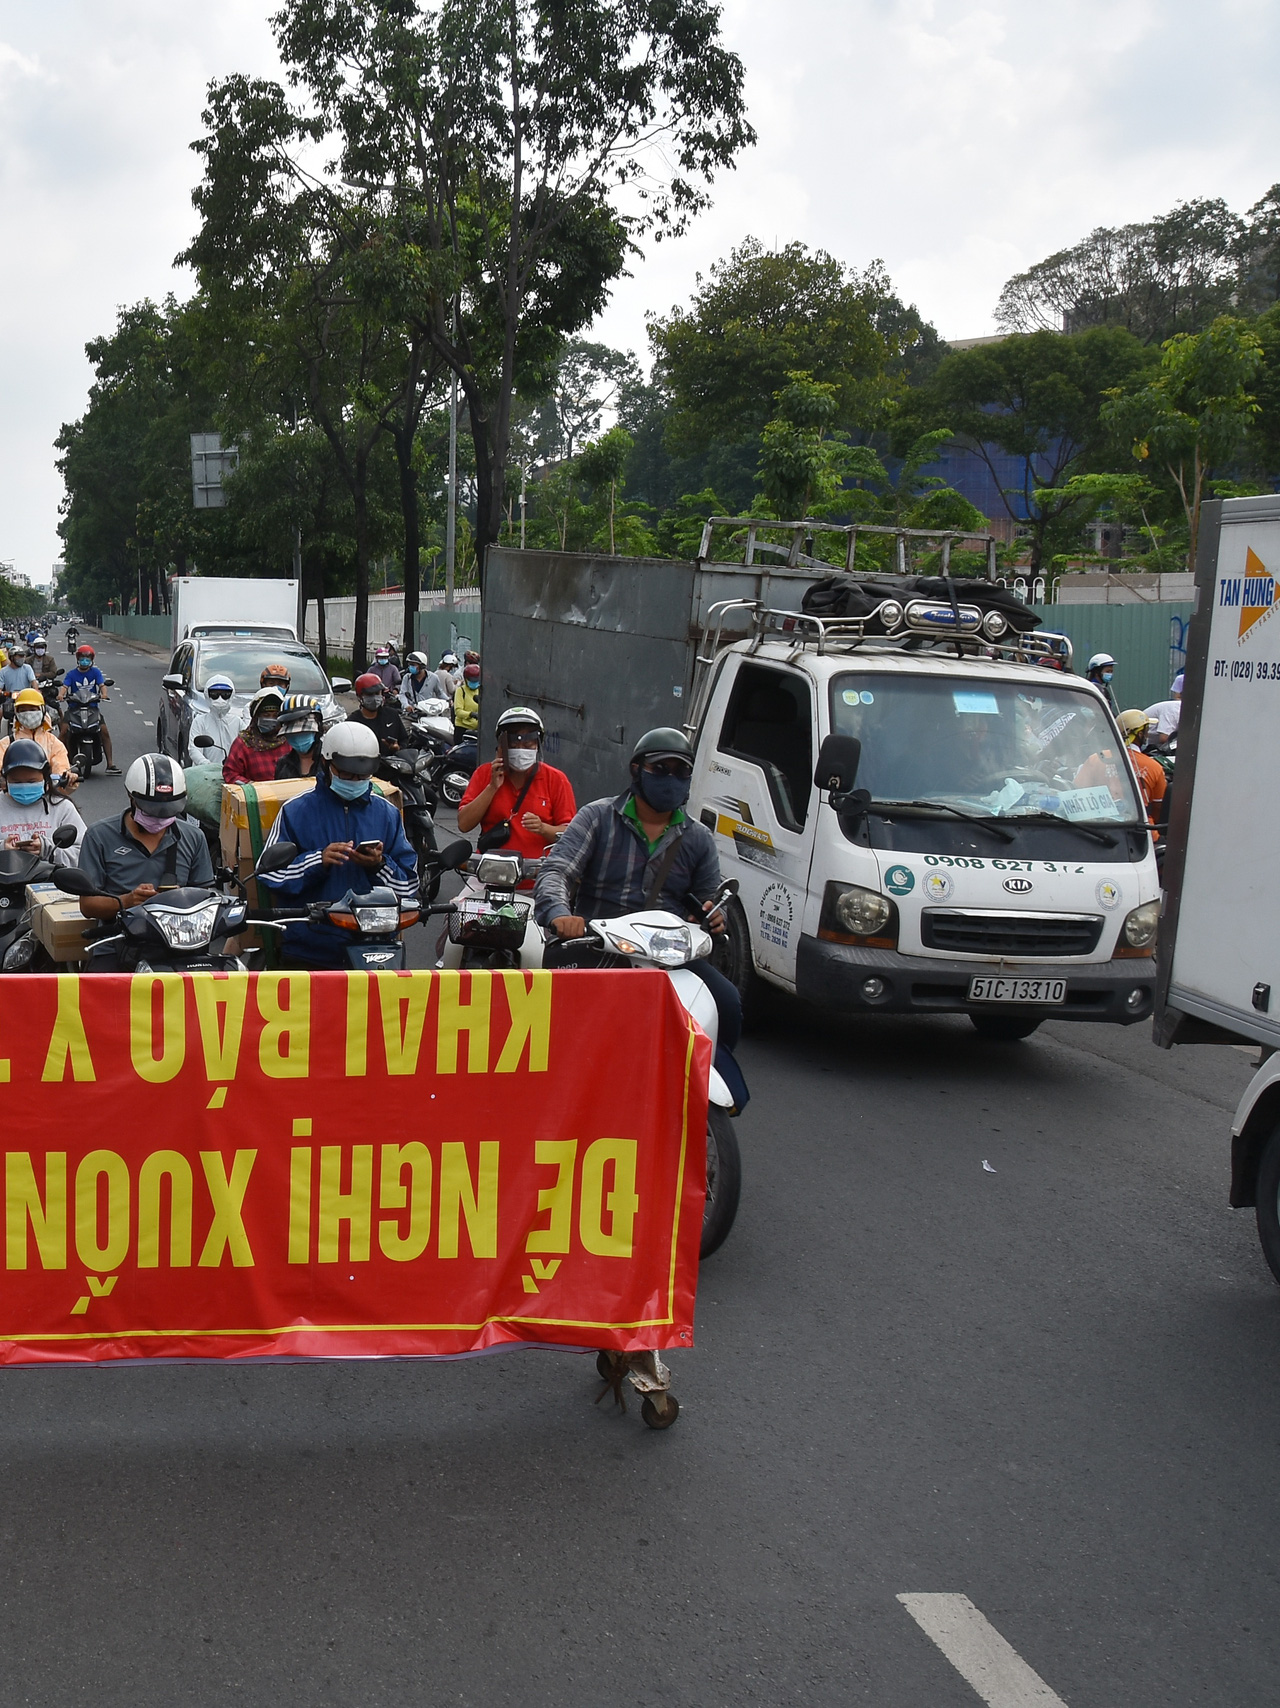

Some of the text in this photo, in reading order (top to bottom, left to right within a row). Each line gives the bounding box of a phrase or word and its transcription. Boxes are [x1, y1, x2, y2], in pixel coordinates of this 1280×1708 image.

[1220, 578, 1242, 607] TAN
[1238, 628, 1254, 648] FAST
[1258, 600, 1280, 627] FASTE
[1214, 660, 1228, 677] ĐT:
[1230, 660, 1254, 682] (028)
[0, 821, 52, 834] SOFTBALL
[924, 855, 986, 870] 0908
[992, 859, 1033, 872] 627
[1008, 879, 1030, 890] KIA
[972, 979, 1063, 1001] 51C-133.10
[42, 974, 96, 1082] Y
[130, 972, 311, 1109] BÁO
[346, 971, 553, 1076] KHAI
[288, 1118, 500, 1264] NGHỊ
[523, 1138, 639, 1293] ĐỀ
